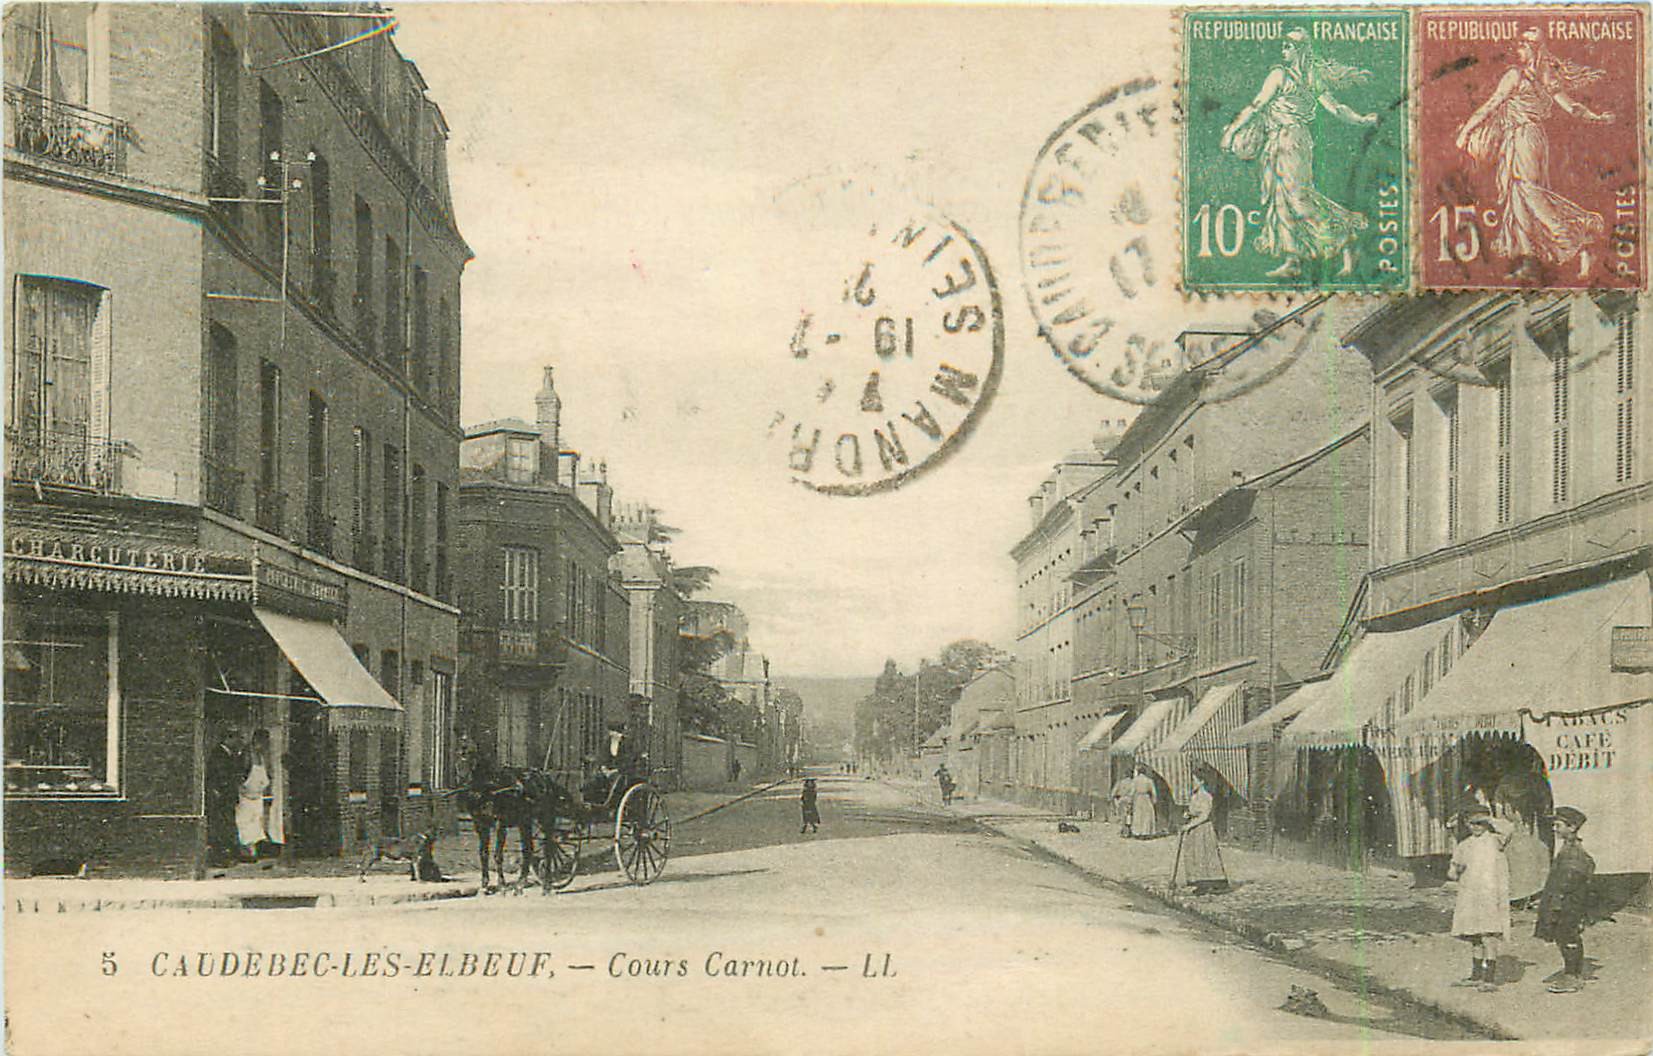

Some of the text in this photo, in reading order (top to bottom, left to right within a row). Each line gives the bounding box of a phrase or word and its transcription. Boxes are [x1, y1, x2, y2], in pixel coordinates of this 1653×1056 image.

[1313, 19, 1399, 42] FRANÇAISE
[1549, 20, 1634, 42] FRANÇAISE
[1378, 183, 1400, 274] POSTES
[1615, 185, 1638, 278] POSTES
[10, 536, 206, 574] CHARCUTERIE
